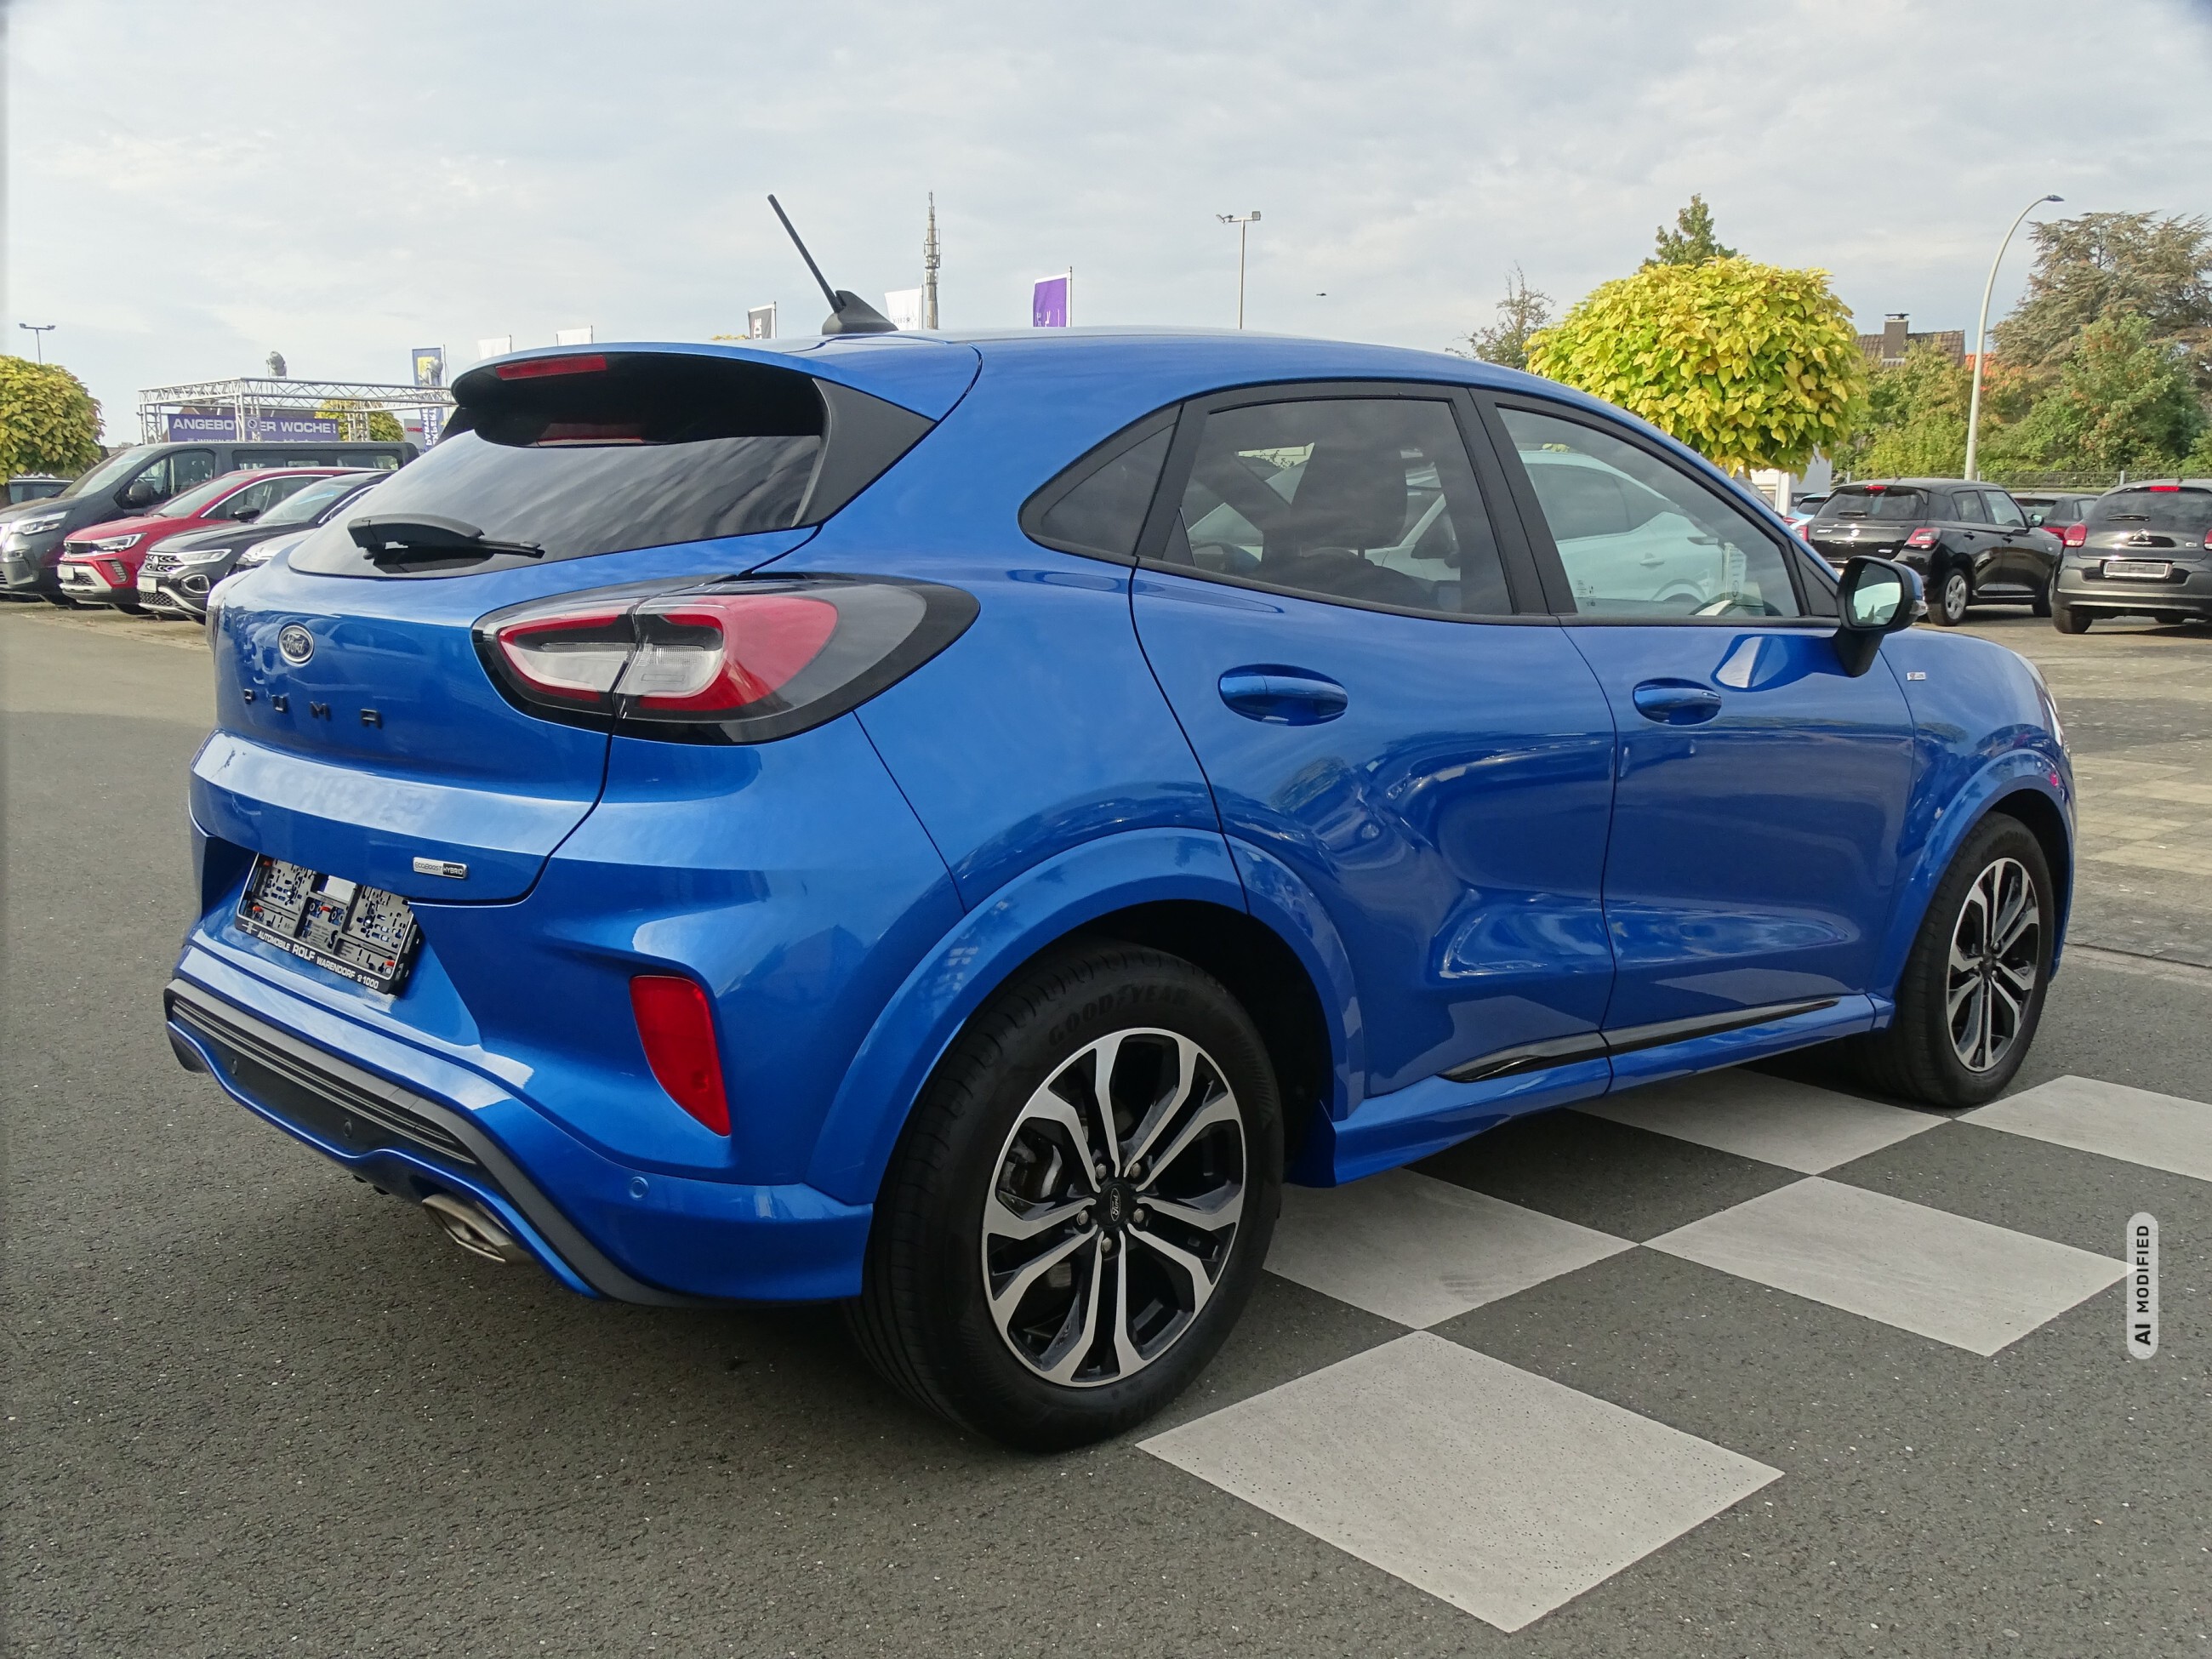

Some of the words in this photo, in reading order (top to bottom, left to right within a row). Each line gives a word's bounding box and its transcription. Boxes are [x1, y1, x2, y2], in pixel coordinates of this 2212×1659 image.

[173, 418, 240, 430] ANGEBO
[281, 422, 336, 434] WOCHE!
[243, 688, 382, 729] PUMA
[443, 866, 463, 875] HYBRID
[257, 931, 290, 951] AUTOMOBILE
[292, 944, 316, 961] ROLF
[316, 955, 356, 979] WARENDORF
[1048, 983, 1189, 1046] GOODYEAR
